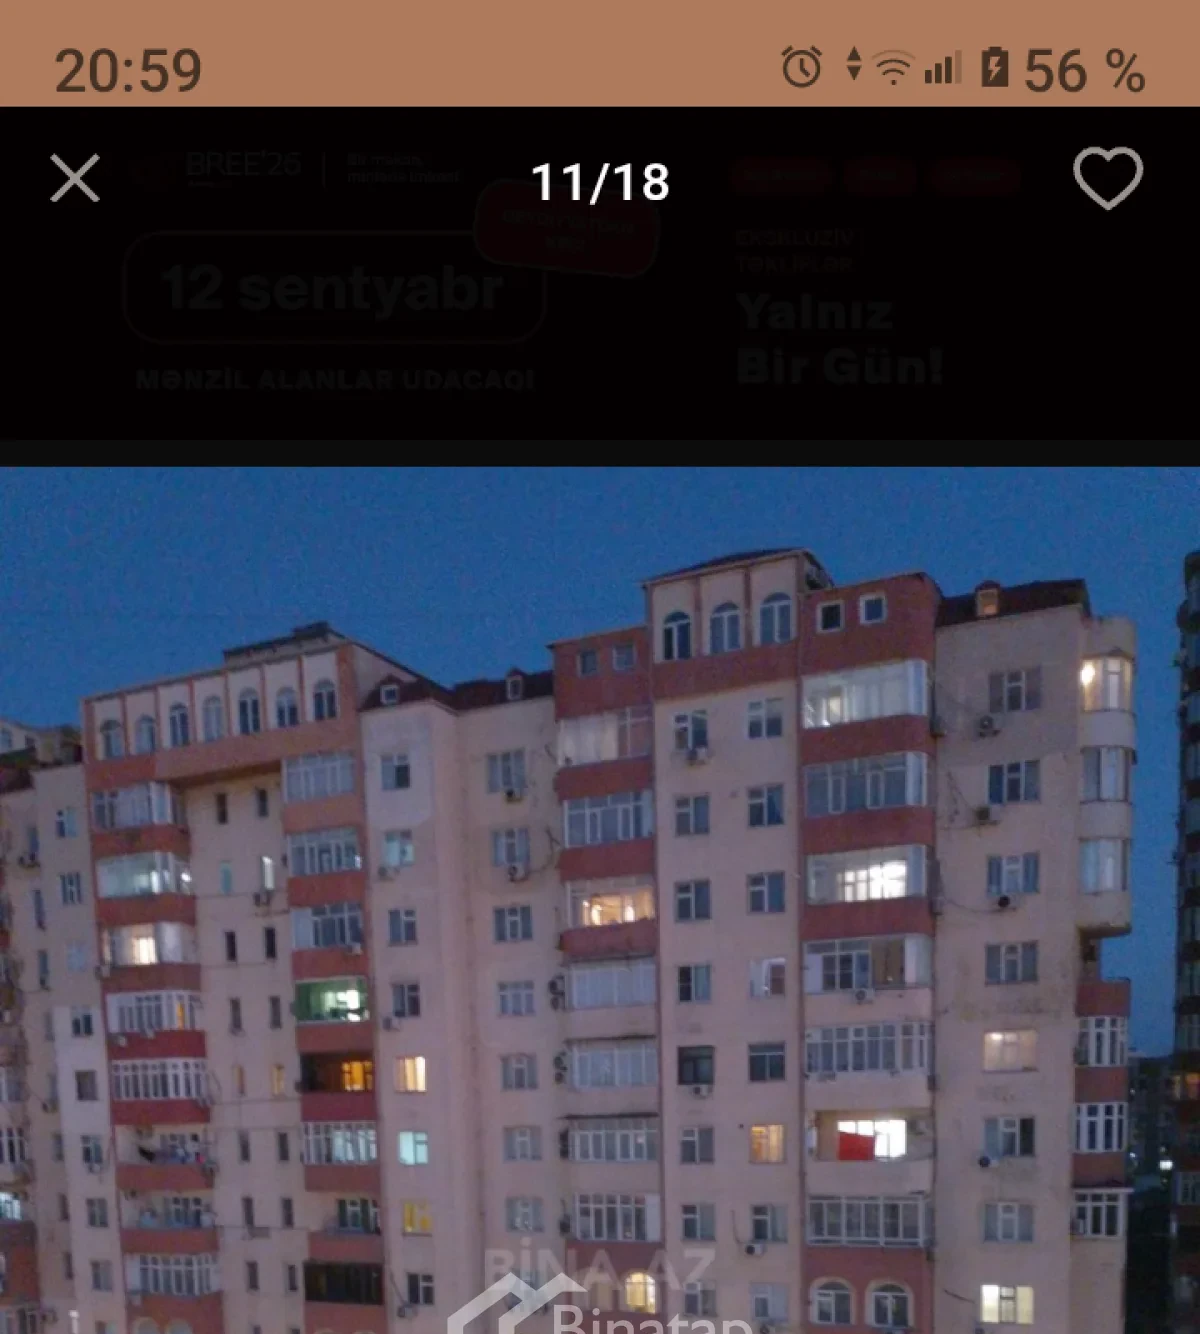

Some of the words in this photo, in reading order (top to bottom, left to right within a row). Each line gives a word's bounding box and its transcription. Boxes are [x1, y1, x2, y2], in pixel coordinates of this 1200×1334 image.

[55, 48, 202, 94] 20:59
[1024, 48, 1088, 93] 56
[1105, 48, 1146, 93] %
[532, 162, 670, 206] 11/18
[160, 264, 224, 311] 12
[237, 264, 504, 323] sentyabr
[735, 293, 895, 331] Yalnız
[736, 346, 810, 386] Bir
[822, 346, 945, 386] Gün!
